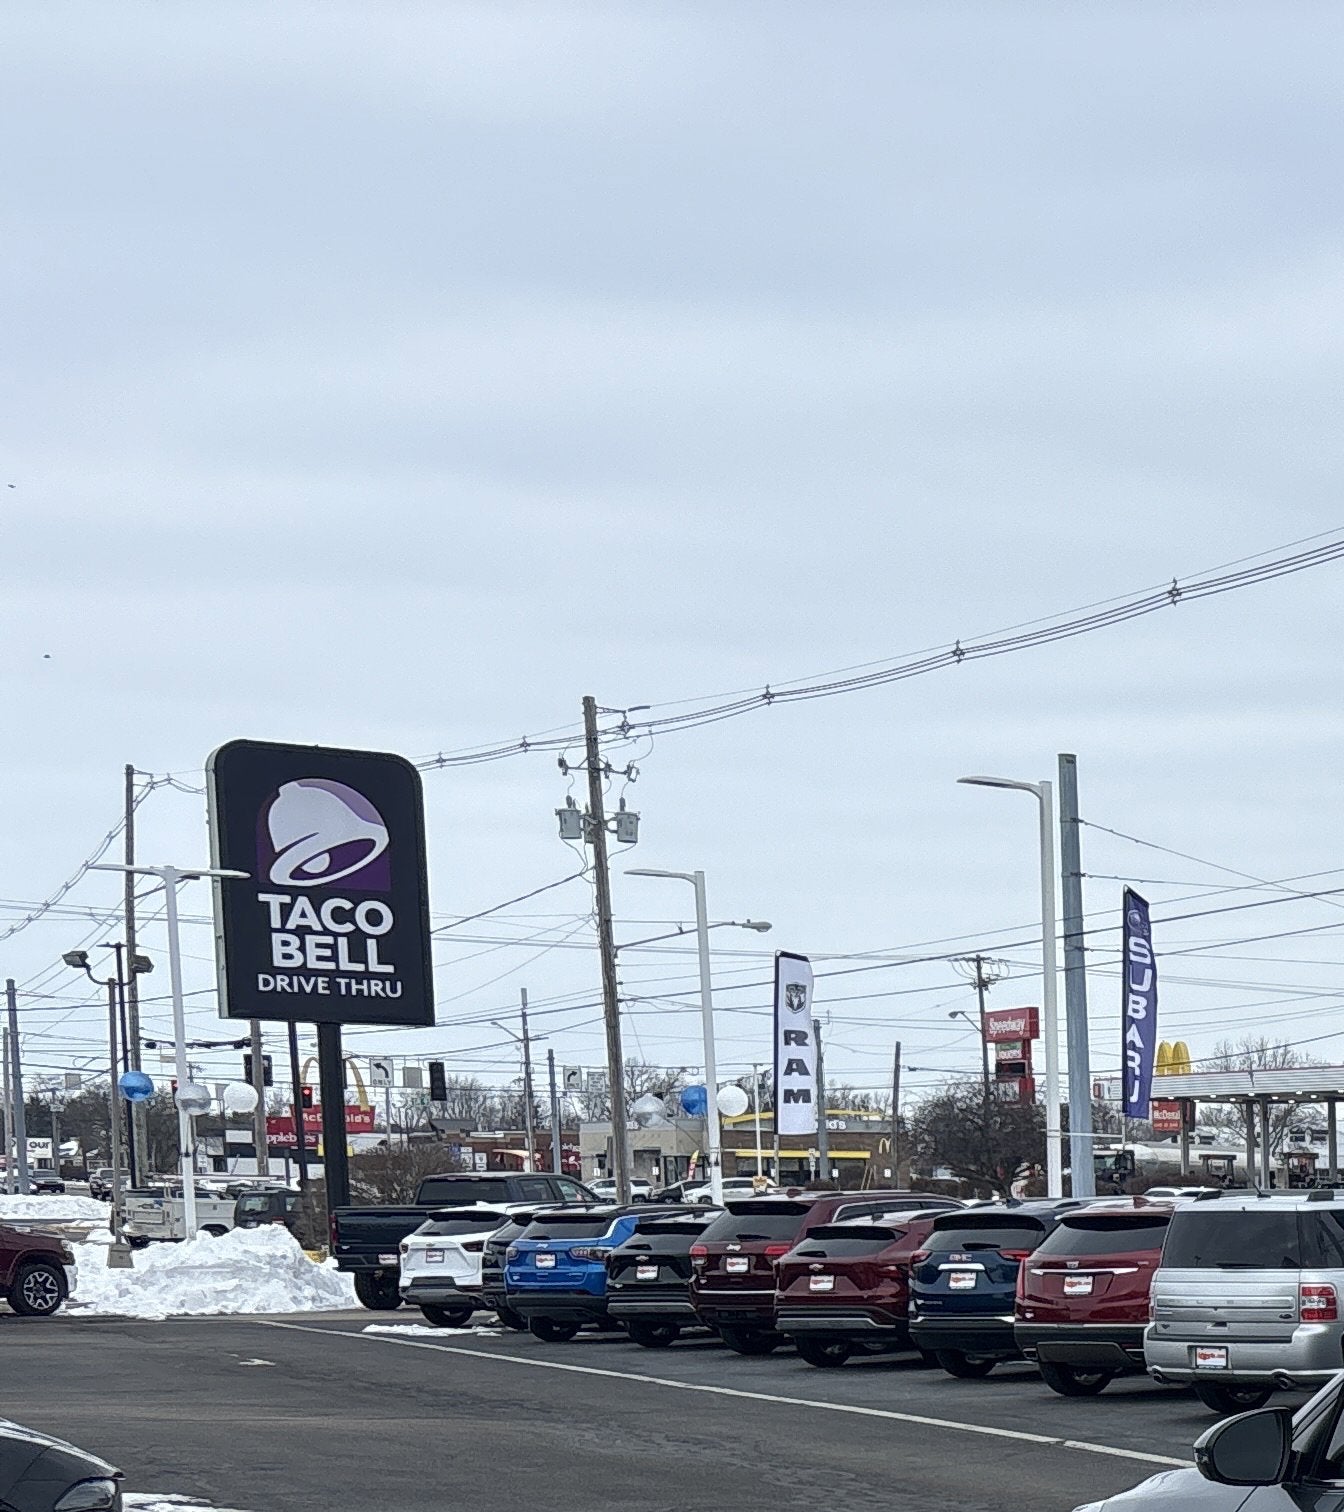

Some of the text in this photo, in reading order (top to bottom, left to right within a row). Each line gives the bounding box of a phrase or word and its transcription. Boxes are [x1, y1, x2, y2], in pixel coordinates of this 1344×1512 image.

[257, 893, 394, 936] TACO
[271, 932, 395, 974] BELL
[257, 974, 402, 998] DRIVE THRU
[783, 1029, 812, 1104] RAM
